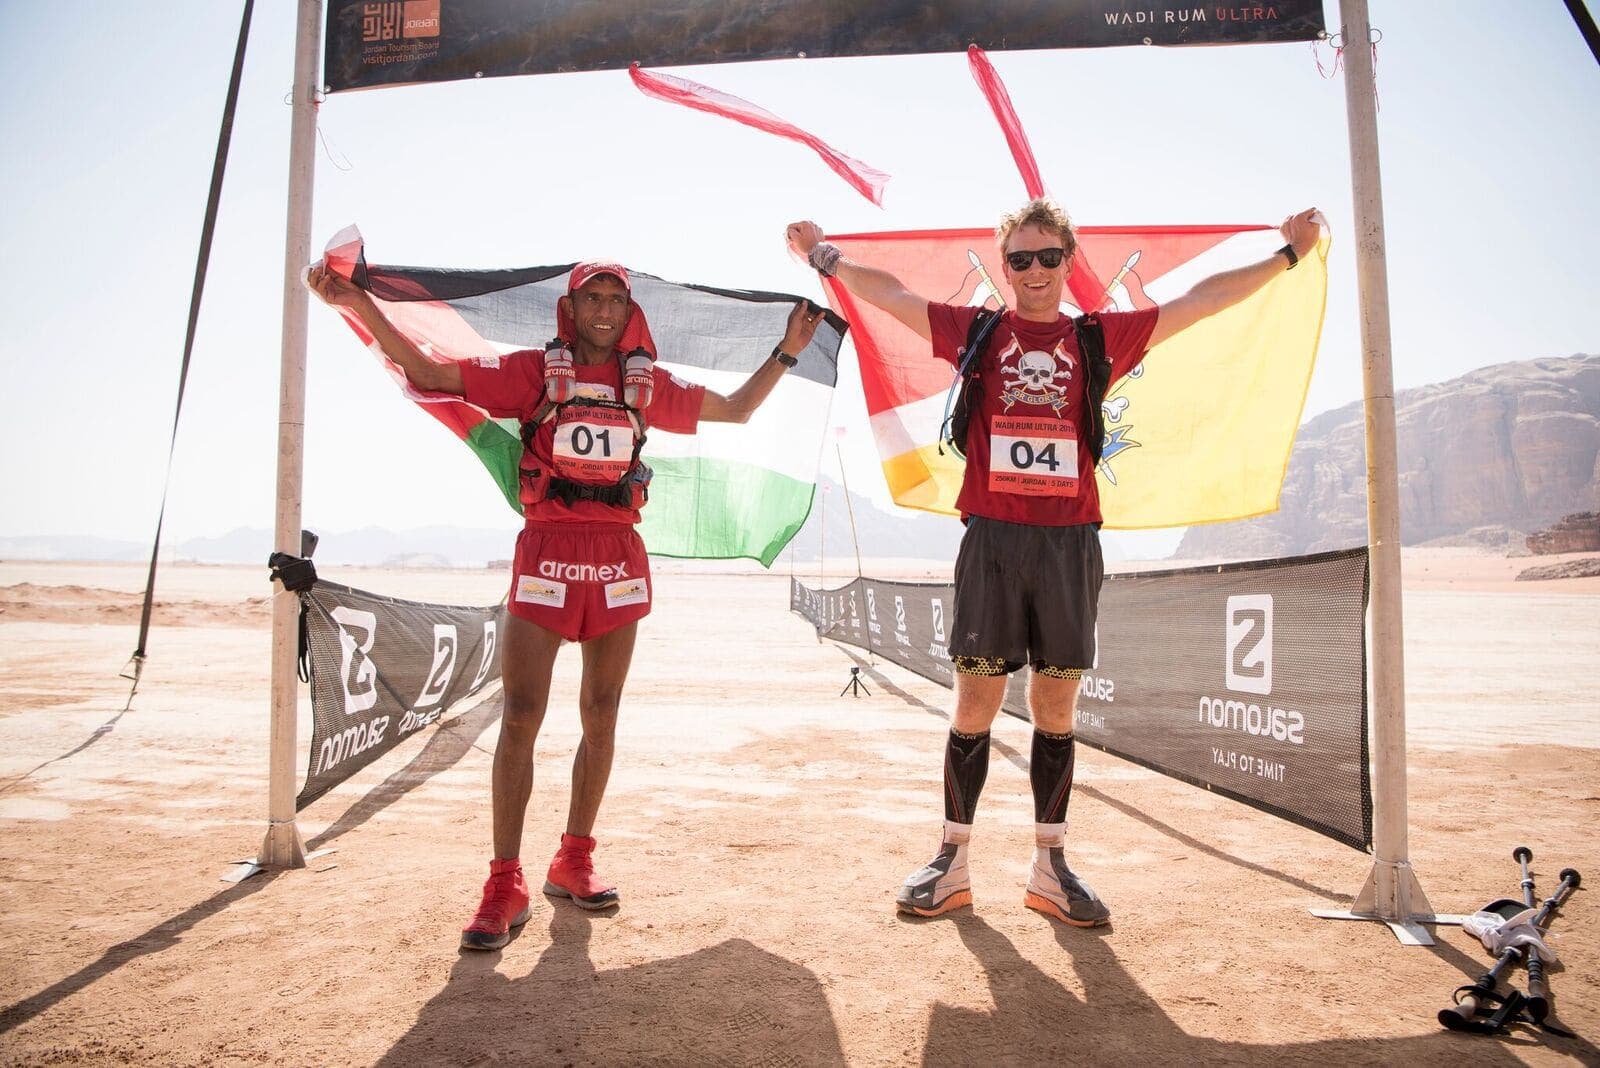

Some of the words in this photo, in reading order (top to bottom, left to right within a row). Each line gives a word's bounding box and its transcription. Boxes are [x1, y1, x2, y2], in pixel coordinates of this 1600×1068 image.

[1104, 11, 1154, 25] WADI
[1165, 8, 1206, 23] RUM
[1216, 7, 1278, 21] ULTRA
[364, 45, 387, 54] Jordan
[389, 43, 417, 53] Tourism
[418, 41, 440, 50] Board
[363, 51, 438, 65] visitjordan.com
[1014, 390, 1024, 399] OR
[1027, 393, 1055, 402] GLORY
[995, 421, 1014, 429] WADI
[1015, 422, 1033, 430] RUM
[1035, 423, 1058, 431] ULTRA
[571, 425, 611, 457] 01
[1010, 440, 1060, 472] 04
[1021, 477, 1047, 486] JORDAN
[1051, 479, 1056, 487] 5
[1057, 480, 1074, 488] DAYS
[539, 560, 629, 582] aramex
